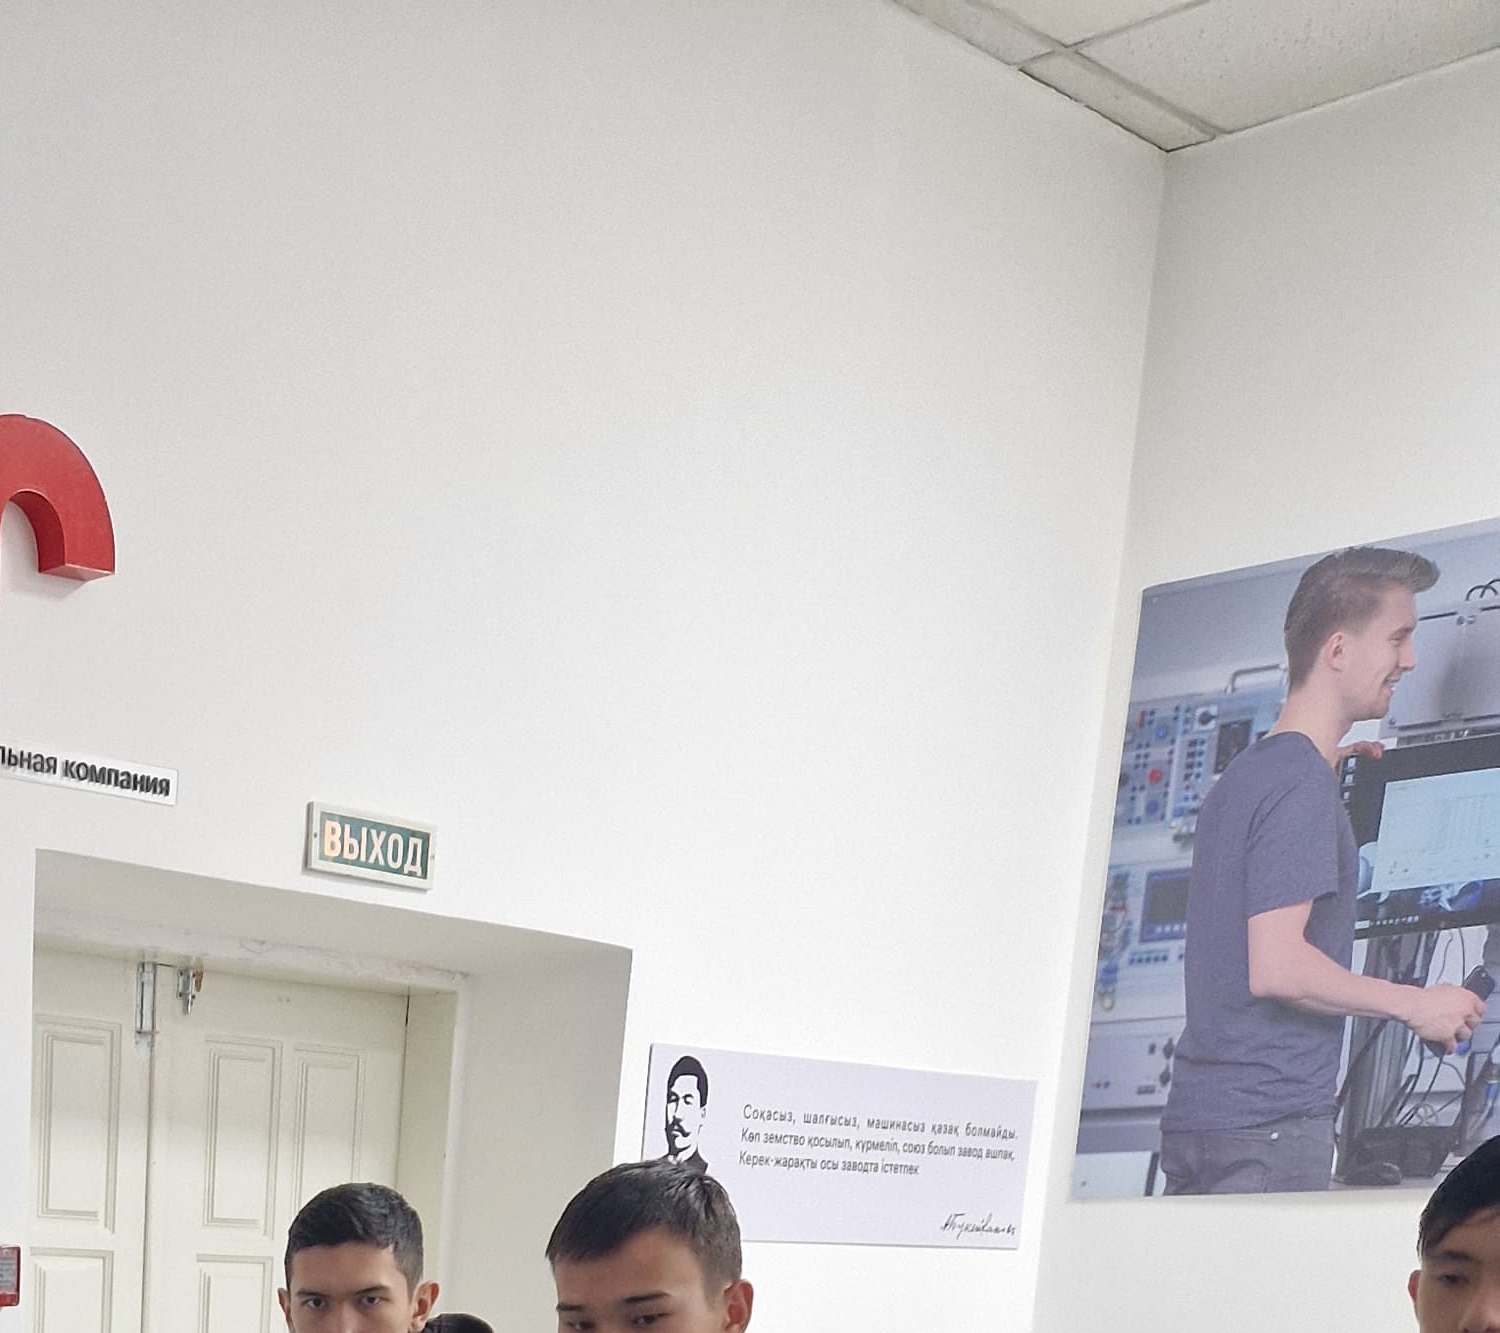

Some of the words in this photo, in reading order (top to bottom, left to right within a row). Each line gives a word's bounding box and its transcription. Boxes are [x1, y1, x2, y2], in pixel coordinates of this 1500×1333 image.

[62, 759, 170, 797] компания
[323, 820, 423, 876] ВЫХОД
[743, 1103, 796, 1125] Соқасыз,
[866, 1117, 926, 1133] машинасыз
[931, 1122, 960, 1137] қазақ
[741, 1127, 760, 1143] Көп
[763, 1133, 806, 1147] земство
[902, 1141, 926, 1155] союз
[927, 1140, 956, 1156] болып
[957, 1146, 983, 1160] завод
[739, 1150, 818, 1171] Керек-жарақты
[820, 1159, 839, 1171] осы
[841, 1161, 879, 1174] заводта
